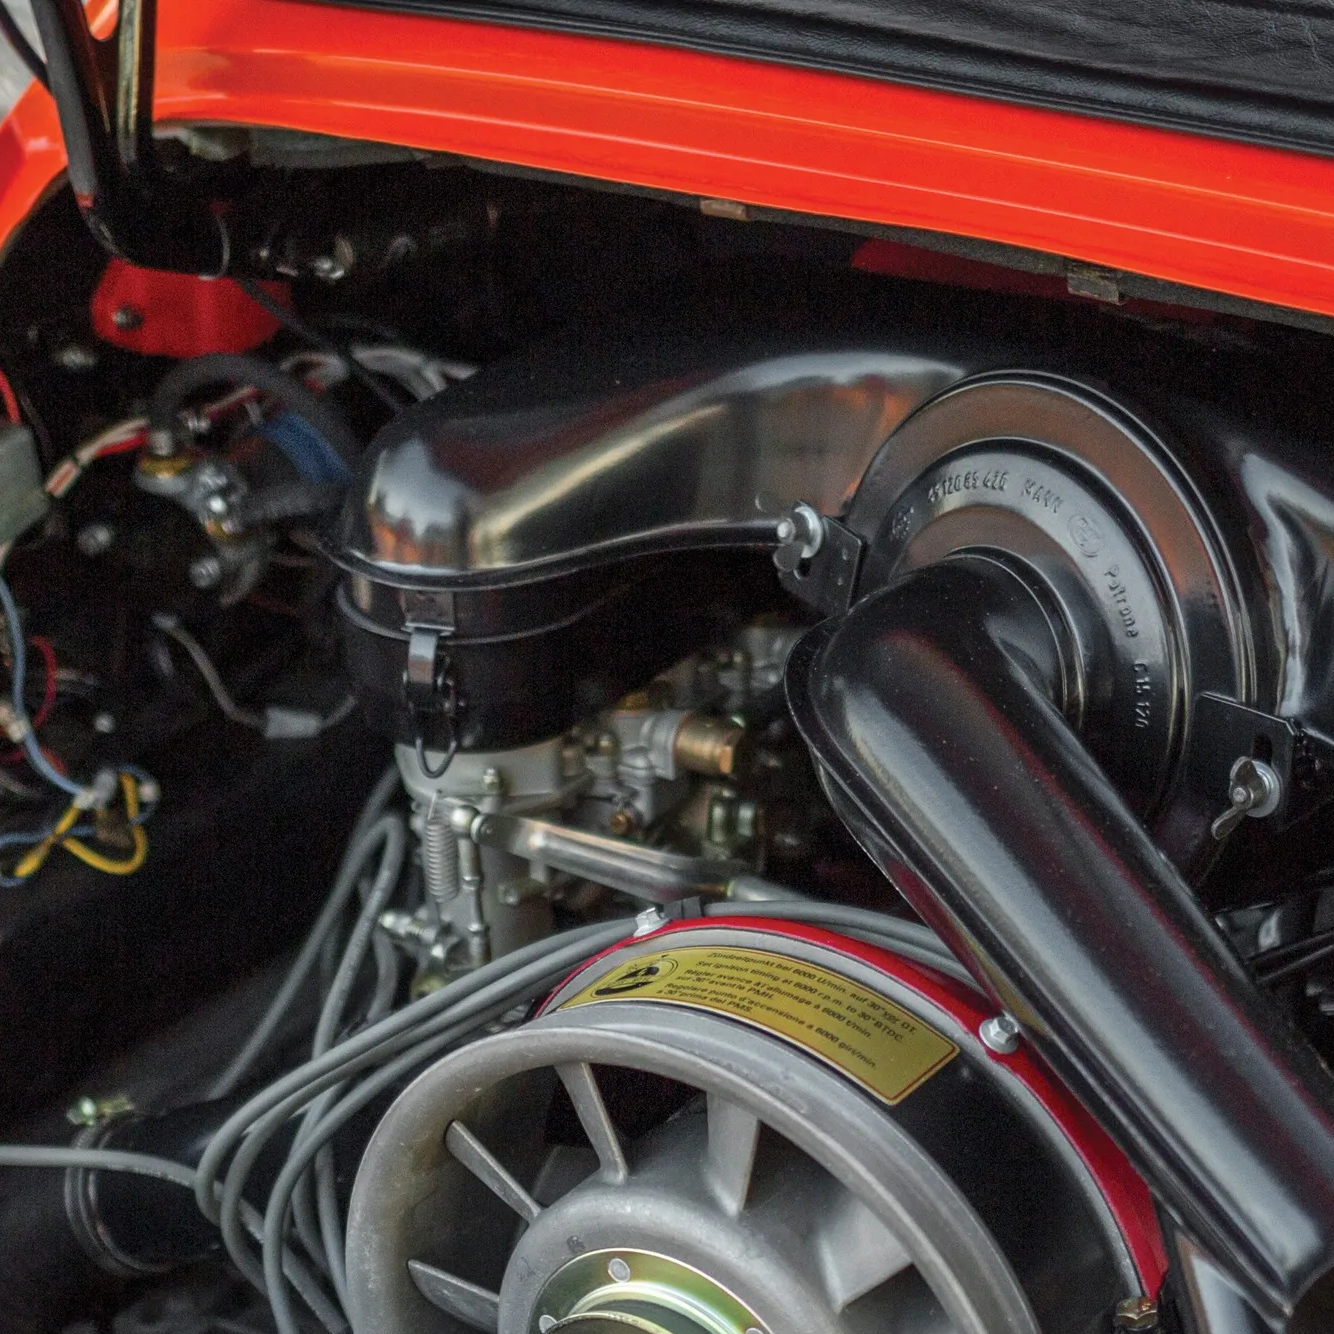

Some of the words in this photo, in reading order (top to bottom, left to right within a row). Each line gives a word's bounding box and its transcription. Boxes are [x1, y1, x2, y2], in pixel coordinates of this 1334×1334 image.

[1104, 564, 1140, 639] Patrone
[793, 968, 816, 980] 6000
[696, 960, 712, 968] Set
[713, 962, 748, 973] ignition
[750, 968, 780, 982] timing
[793, 981, 817, 994] 6000
[846, 1004, 857, 1014] to
[822, 1006, 846, 1021] 6000
[814, 1026, 839, 1043] 6000
